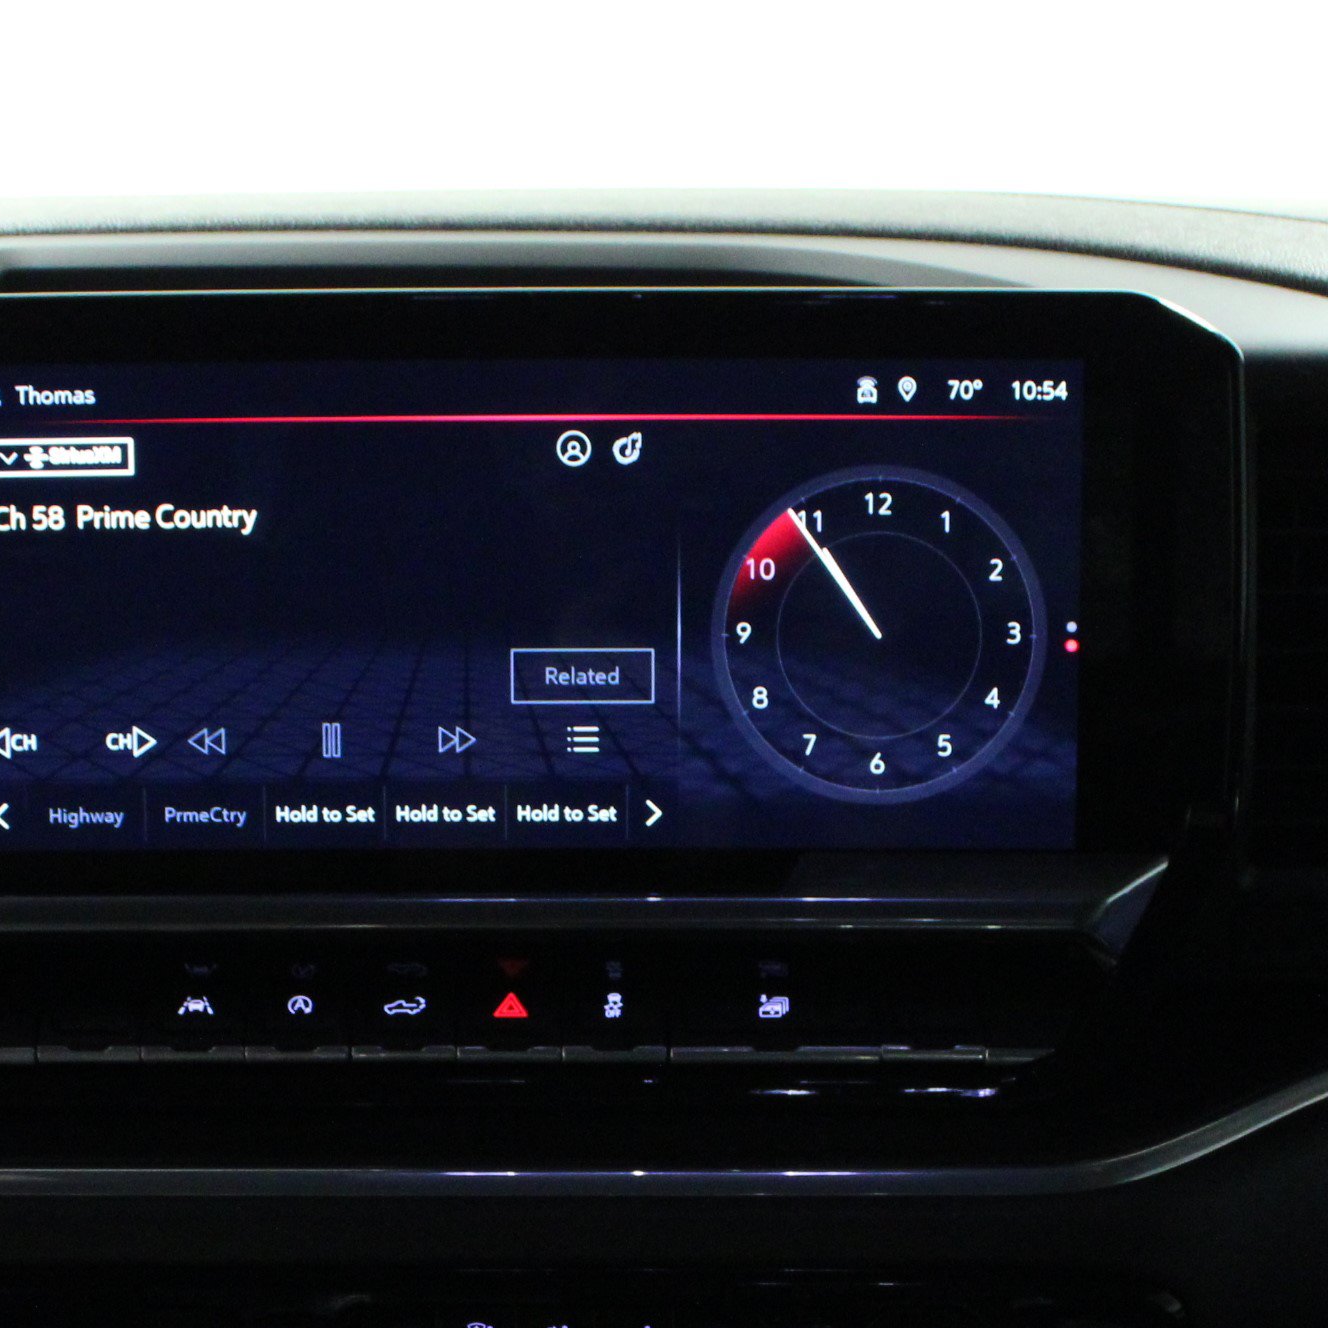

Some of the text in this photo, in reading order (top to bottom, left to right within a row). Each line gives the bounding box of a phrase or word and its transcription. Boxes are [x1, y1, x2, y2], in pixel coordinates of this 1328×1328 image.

[14, 384, 97, 406] Thomas
[1011, 379, 1069, 402] 10:54
[863, 492, 893, 516] 12
[31, 504, 66, 531] 58
[76, 504, 151, 530] Prime
[154, 503, 258, 535] Country
[939, 510, 952, 534] 1
[744, 556, 776, 581] 10
[987, 557, 1004, 582] 2
[734, 621, 753, 645] 9
[1005, 621, 1023, 645] 3
[544, 666, 620, 686] Related
[750, 685, 770, 710] 8
[983, 686, 1002, 710] 4
[10, 733, 38, 752] CH
[105, 732, 132, 751] CH
[801, 733, 818, 757] 7
[936, 733, 954, 758] 5
[868, 752, 886, 776] 6
[48, 806, 125, 829] Highway
[163, 806, 247, 829] PrmeCtry
[275, 804, 376, 823] Hold to Set
[395, 803, 496, 823] Hold to Set
[516, 803, 618, 823] Hold to Set
